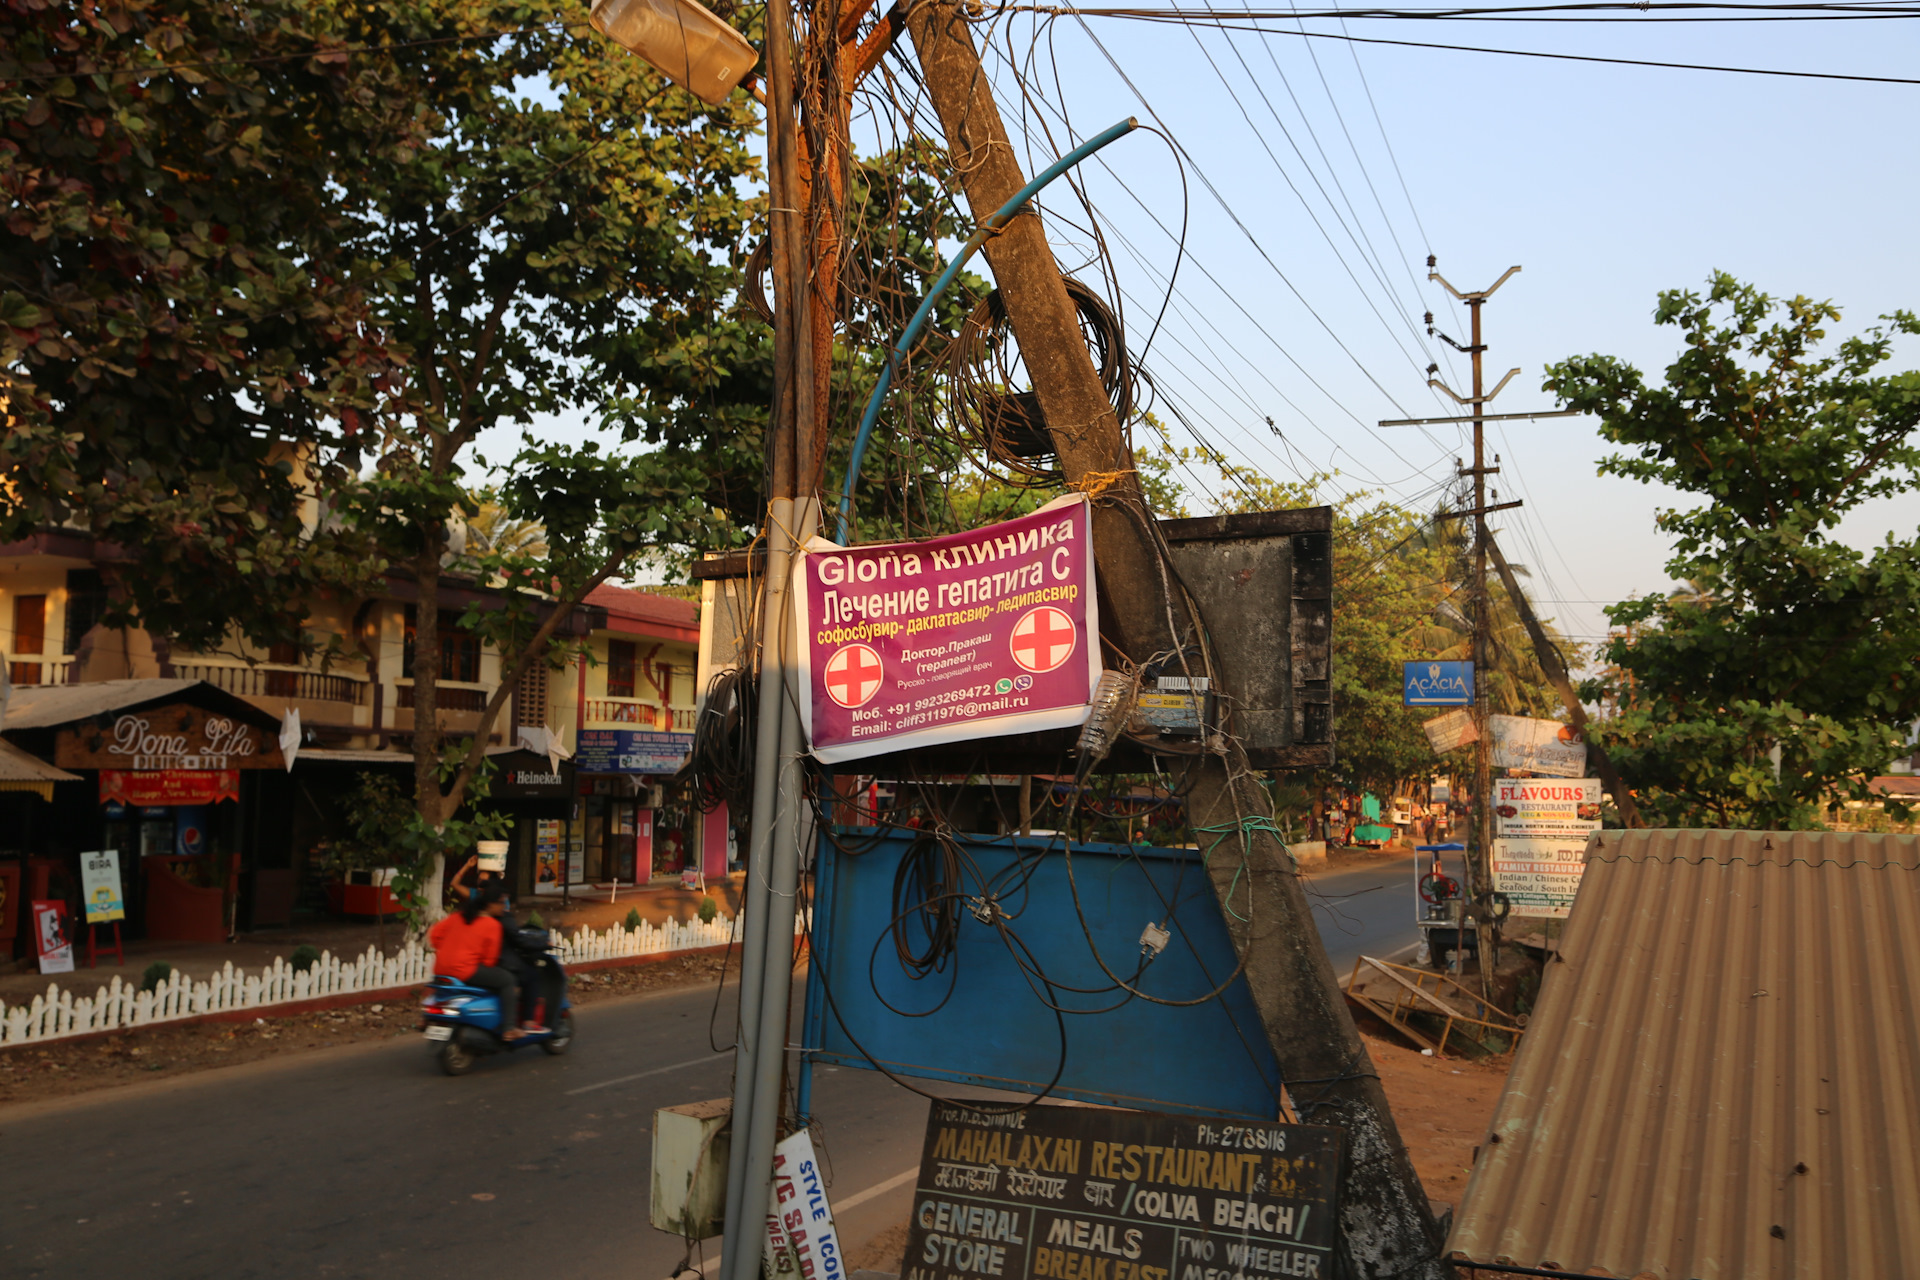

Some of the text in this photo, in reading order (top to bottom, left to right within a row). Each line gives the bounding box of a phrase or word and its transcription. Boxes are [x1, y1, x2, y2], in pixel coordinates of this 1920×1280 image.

[818, 518, 1075, 586] Gloria клиника
[822, 586, 930, 625] Лечение
[937, 562, 1043, 608] гепатита
[995, 583, 1078, 614] ледипасвир
[897, 676, 925, 690] Русско
[973, 661, 993, 676] врач
[916, 649, 976, 676] (терапевт)
[852, 684, 991, 723] Моб. +91 9923269472
[1408, 676, 1470, 697] ACACIA
[852, 695, 1029, 738] Email: cliff311976@mail.ru
[108, 714, 255, 756] Dona Lila
[516, 770, 562, 785] Heineken
[1500, 787, 1583, 801] FLAVOURS
[1521, 803, 1573, 811] RESTAURANT
[89, 859, 112, 870] BIRA
[1498, 863, 1531, 872] FAMILY
[1499, 873, 1528, 882] Indian
[1535, 875, 1569, 884] Chinese
[1499, 883, 1533, 891] Seafood
[1541, 885, 1567, 893] South
[932, 1128, 1081, 1175] MAHALAXMI
[1090, 1141, 1262, 1194] RESTAURANT
[800, 1160, 826, 1222] STYLE
[918, 1200, 1023, 1245] GENERAL
[1047, 1218, 1143, 1260] MEALS
[923, 1233, 1006, 1276] STORE
[1179, 1236, 1215, 1261] TWO
[1226, 1242, 1321, 1279] WHEELER
